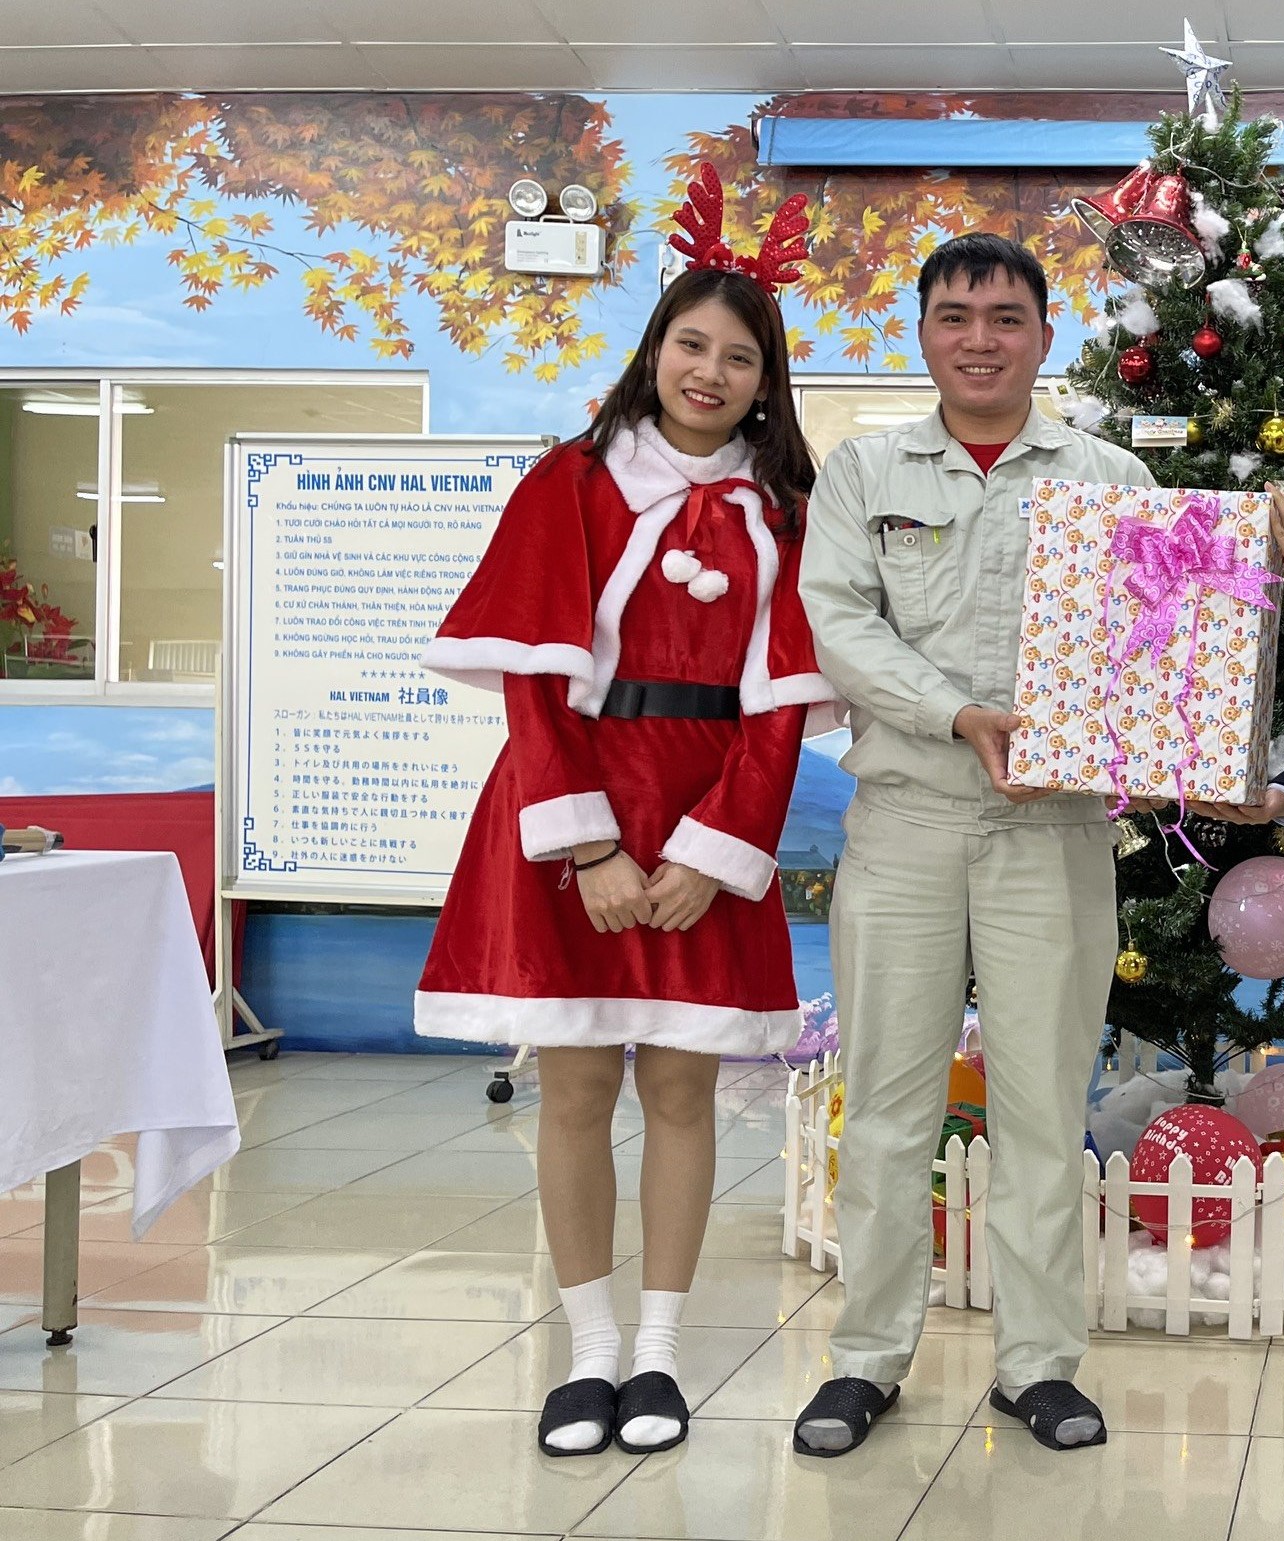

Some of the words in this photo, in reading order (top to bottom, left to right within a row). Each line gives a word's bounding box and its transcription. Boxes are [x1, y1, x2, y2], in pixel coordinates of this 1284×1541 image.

[297, 470, 330, 490] HÌNH
[335, 467, 363, 490] ẢNH
[369, 475, 396, 490] CNV
[401, 475, 426, 491] HAL
[431, 475, 492, 492] VIETNAM
[321, 501, 351, 511] CHÚNG
[355, 503, 363, 511] TA
[365, 502, 387, 511] LUÔN
[434, 504, 452, 512] CNV
[440, 571, 465, 579] TRONG
[330, 691, 347, 700] HAL
[350, 691, 390, 702] VIETNAM
[398, 687, 448, 705] 社員像
[1154, 1116, 1189, 1140] Happy
